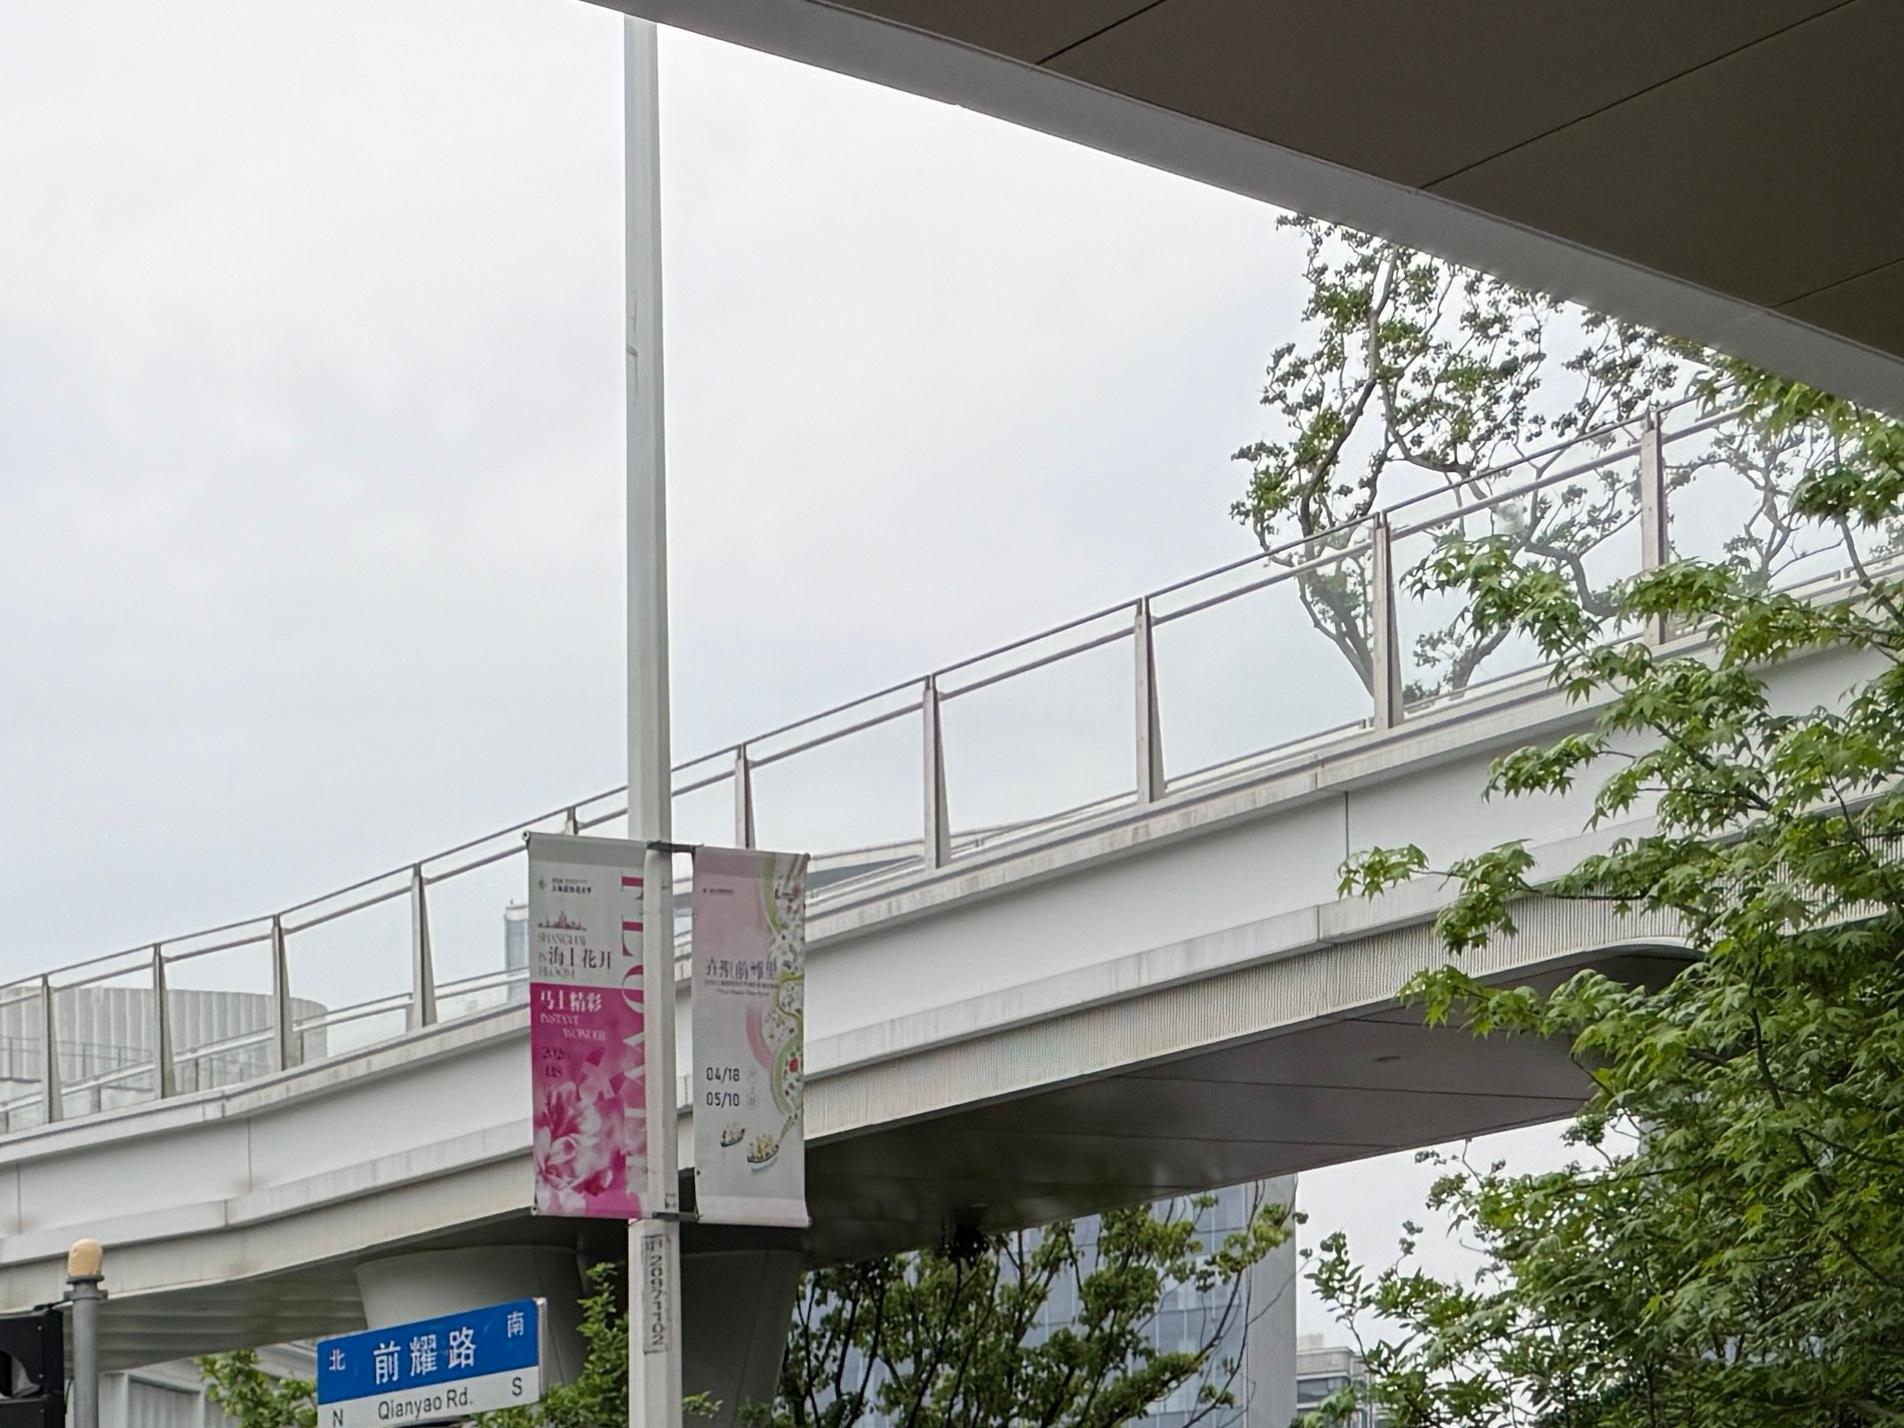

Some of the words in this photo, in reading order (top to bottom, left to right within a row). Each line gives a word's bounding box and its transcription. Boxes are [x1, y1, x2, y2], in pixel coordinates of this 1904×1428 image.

[705, 1066, 741, 1085] 04/18
[705, 1091, 741, 1109] 05/10
[506, 1310, 525, 1339] 南
[328, 1348, 346, 1372] 北
[373, 1326, 478, 1385] 前耀路
[510, 1376, 523, 1397] S
[377, 1394, 443, 1421] Qianyao
[445, 1388, 473, 1409] Rd.
[332, 1408, 344, 1428] N
